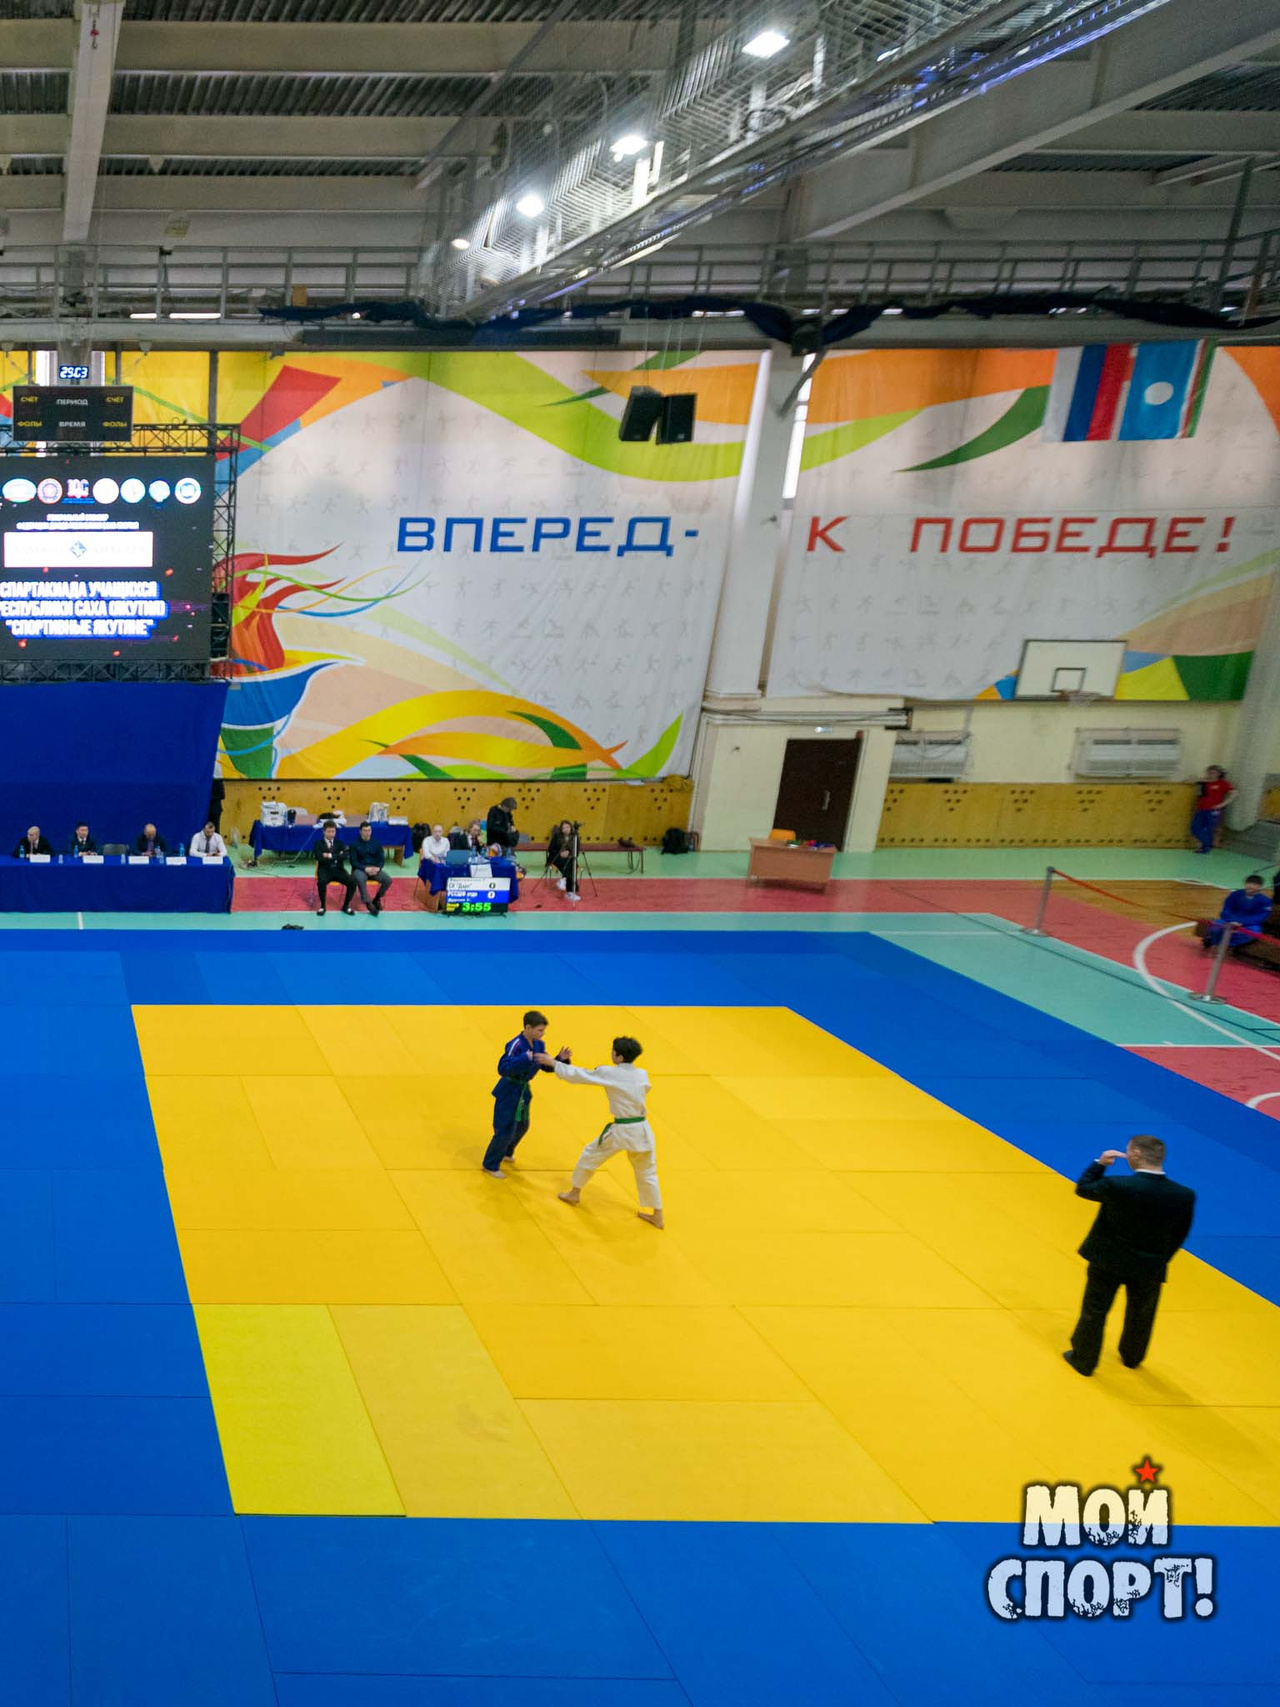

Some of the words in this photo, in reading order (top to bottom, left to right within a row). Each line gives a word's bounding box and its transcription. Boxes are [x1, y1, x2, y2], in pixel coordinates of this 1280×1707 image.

[56, 398, 88, 406] ПЕРИОД
[18, 420, 42, 428] ФОЛЫ
[102, 420, 127, 428] ФОЛЫ
[806, 516, 851, 552] К
[909, 516, 1236, 559] ПОБЕДЕ!
[487, 891, 496, 899] 0
[462, 902, 491, 911] 3:55
